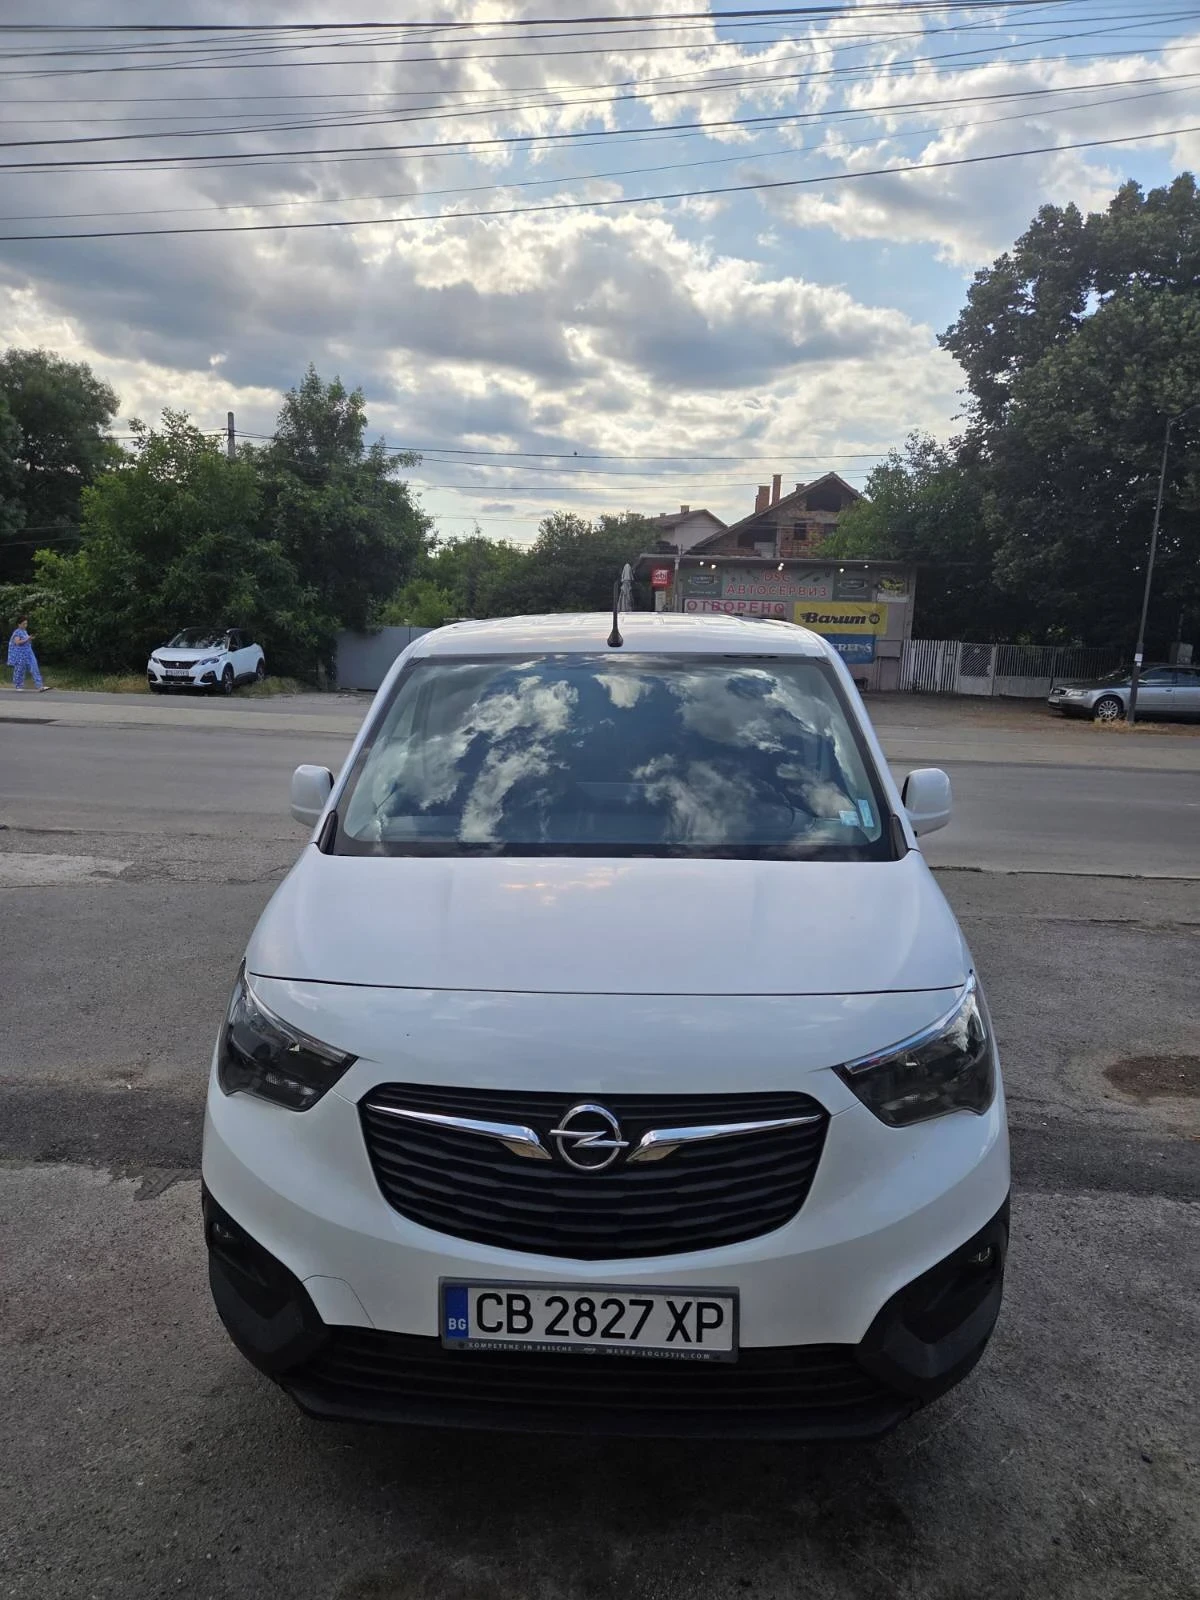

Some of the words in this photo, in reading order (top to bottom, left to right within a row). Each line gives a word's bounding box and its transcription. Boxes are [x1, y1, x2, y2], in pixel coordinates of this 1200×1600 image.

[726, 583, 828, 597] АВТОСЕРВИЗ
[686, 600, 785, 614] ОТВОРЕНО
[801, 612, 867, 625] Barum
[448, 1318, 467, 1330] BG
[476, 1292, 534, 1335] CB
[544, 1295, 654, 1340] 2827
[665, 1300, 724, 1344] XP
